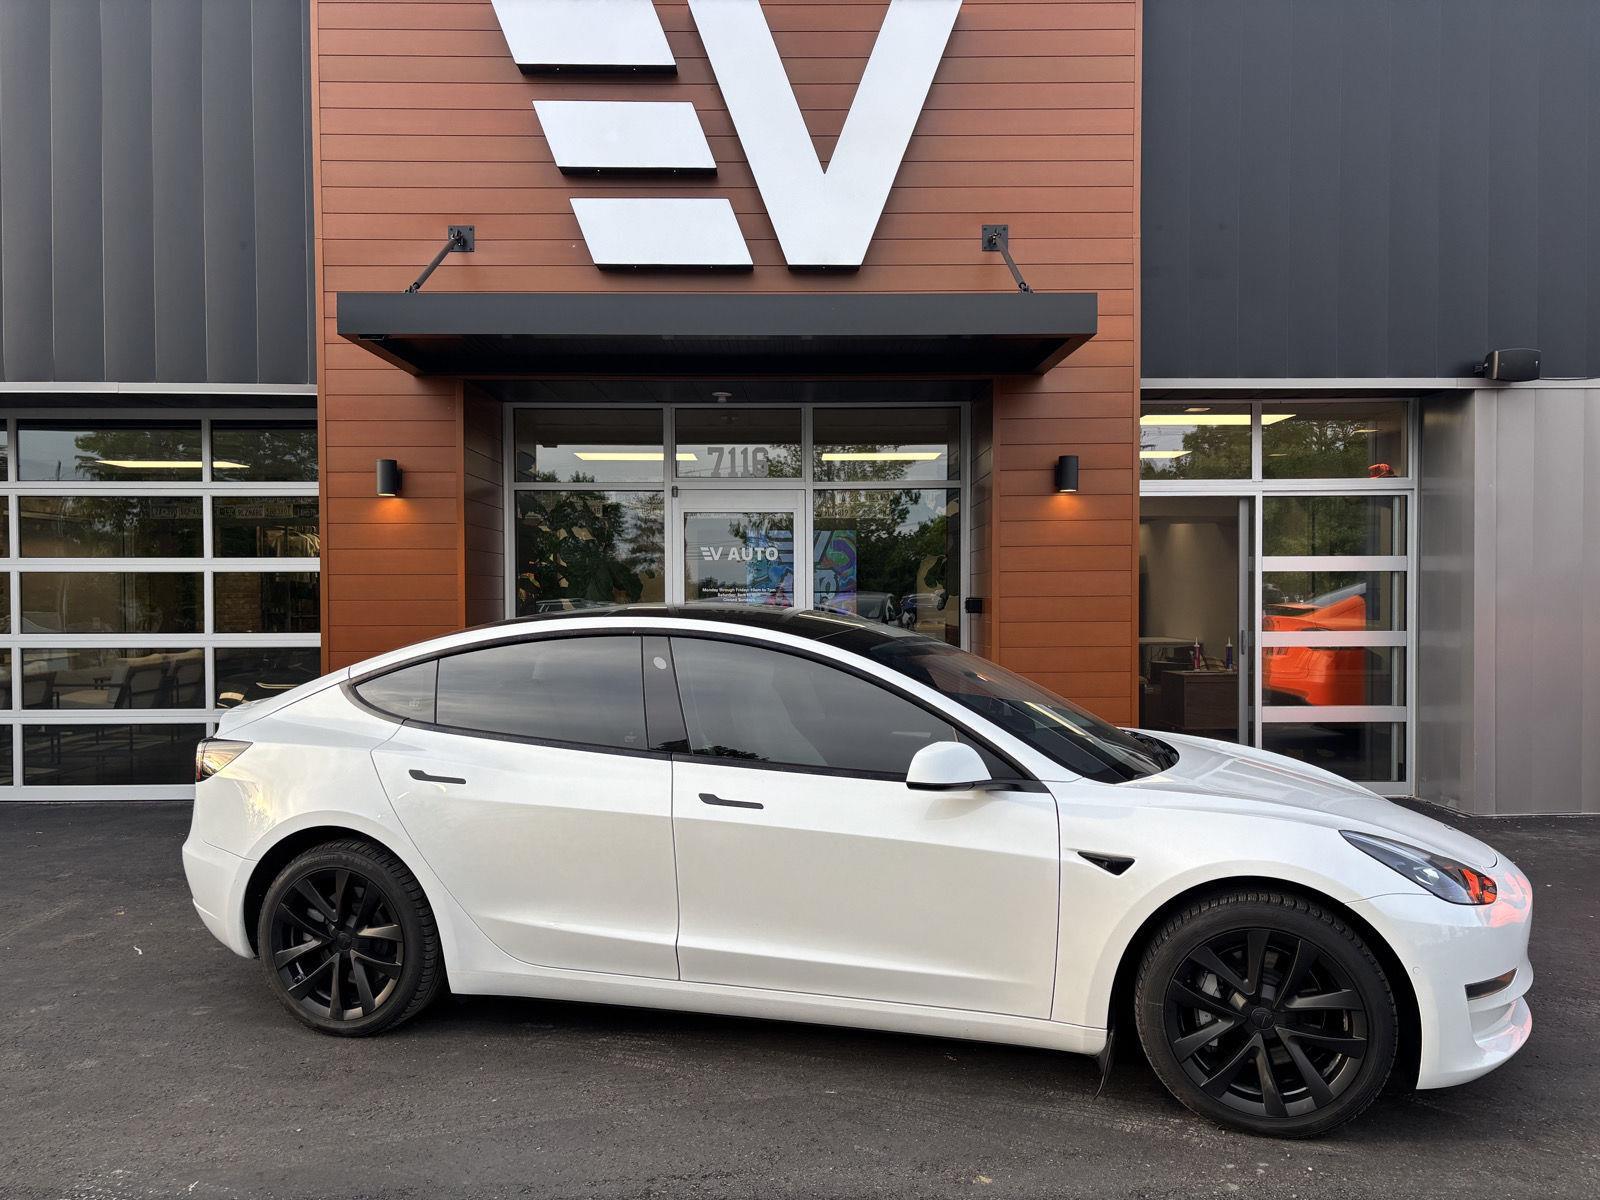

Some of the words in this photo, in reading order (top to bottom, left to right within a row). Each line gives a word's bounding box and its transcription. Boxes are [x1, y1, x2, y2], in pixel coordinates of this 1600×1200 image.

[707, 447, 769, 478] 7116
[701, 547, 723, 561] EV
[728, 547, 779, 561] AUTO
